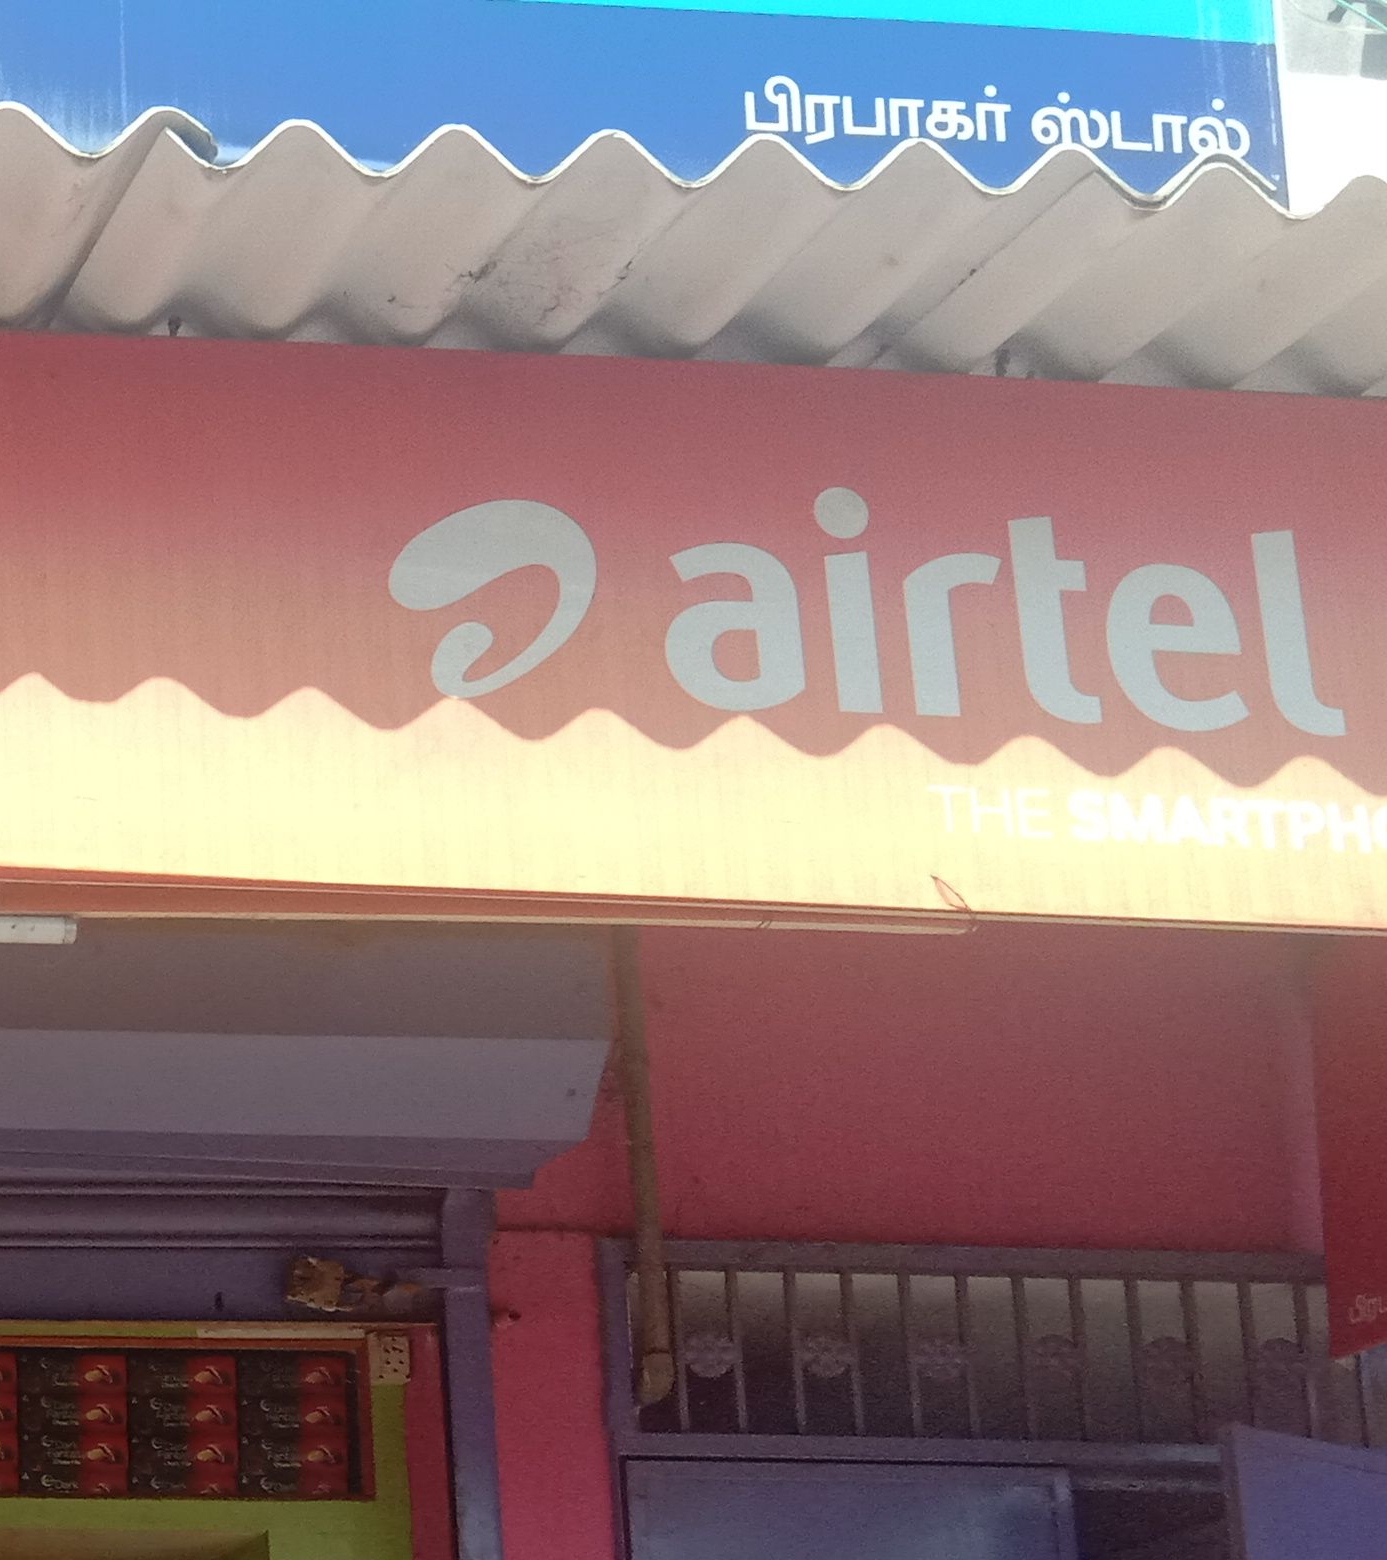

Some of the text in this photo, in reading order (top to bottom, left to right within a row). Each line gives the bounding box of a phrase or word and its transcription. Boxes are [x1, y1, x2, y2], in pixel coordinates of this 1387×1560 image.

[744, 75, 1251, 157] பிரபாகர் ஸ்டால்
[664, 486, 1347, 737] airtel
[926, 784, 1387, 856] THE SMARTPH
